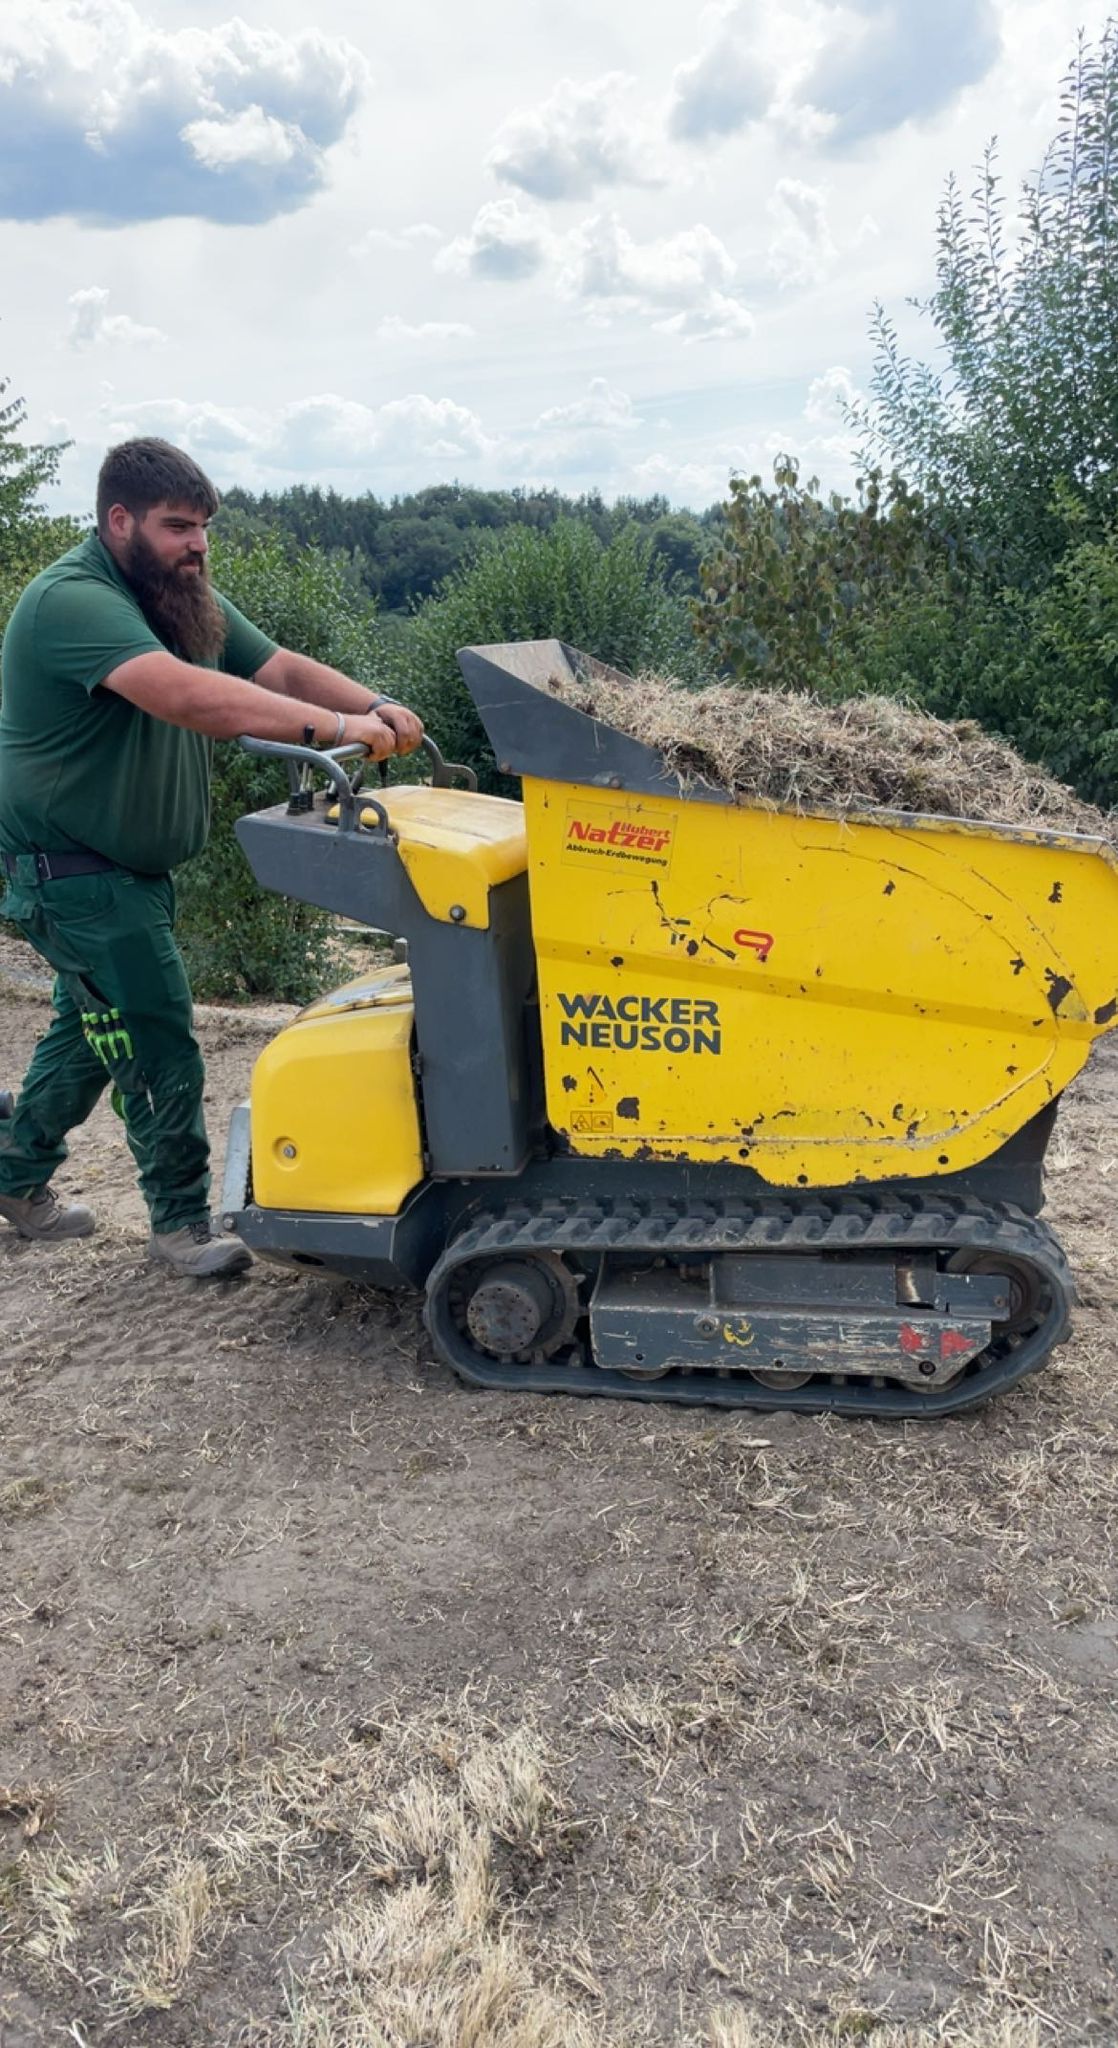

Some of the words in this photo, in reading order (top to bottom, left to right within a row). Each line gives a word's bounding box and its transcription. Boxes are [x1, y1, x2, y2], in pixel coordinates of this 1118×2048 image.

[567, 820, 671, 852] Natzer
[620, 822, 671, 838] Hubert
[566, 843, 668, 867] Abbruch-Erdbewegung
[557, 993, 721, 1026] WACKER
[561, 1021, 722, 1055] NEUSON
